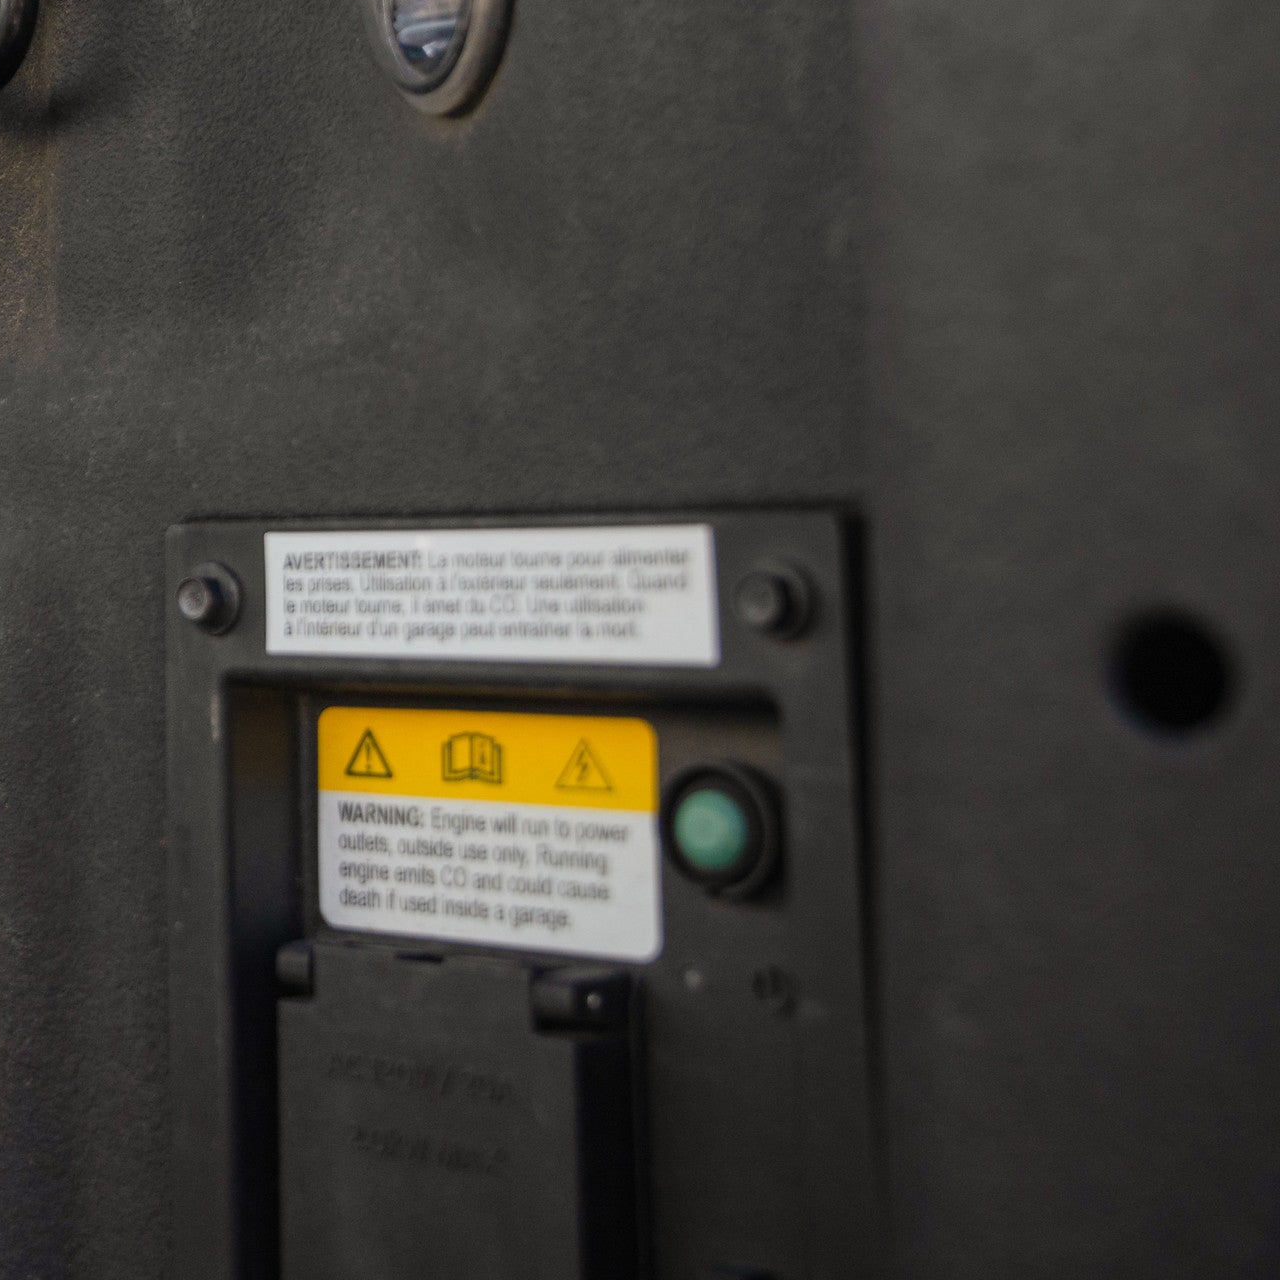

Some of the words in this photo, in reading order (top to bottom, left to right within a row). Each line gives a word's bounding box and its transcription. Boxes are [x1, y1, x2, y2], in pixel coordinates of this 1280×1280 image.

[283, 551, 422, 570] AVERTISSEMENT:
[360, 574, 431, 592] Utilisation
[300, 597, 349, 614] moteur
[403, 621, 456, 642] garage
[338, 801, 424, 828] WARNING:
[431, 806, 486, 835] Engine
[490, 811, 518, 834] will
[521, 817, 549, 837] run
[554, 816, 571, 838] to
[575, 821, 630, 844] power
[338, 832, 392, 856] outlets,
[397, 837, 454, 858] outside
[458, 843, 488, 860] use
[536, 843, 608, 876] Running
[339, 861, 389, 884] engine
[394, 865, 435, 885] emits
[440, 865, 467, 887] CO
[472, 870, 502, 891] and
[507, 875, 553, 896] could
[557, 880, 610, 901] cause
[339, 886, 381, 908] death
[399, 893, 437, 914] used
[441, 896, 489, 919] inside
[494, 904, 505, 922] a
